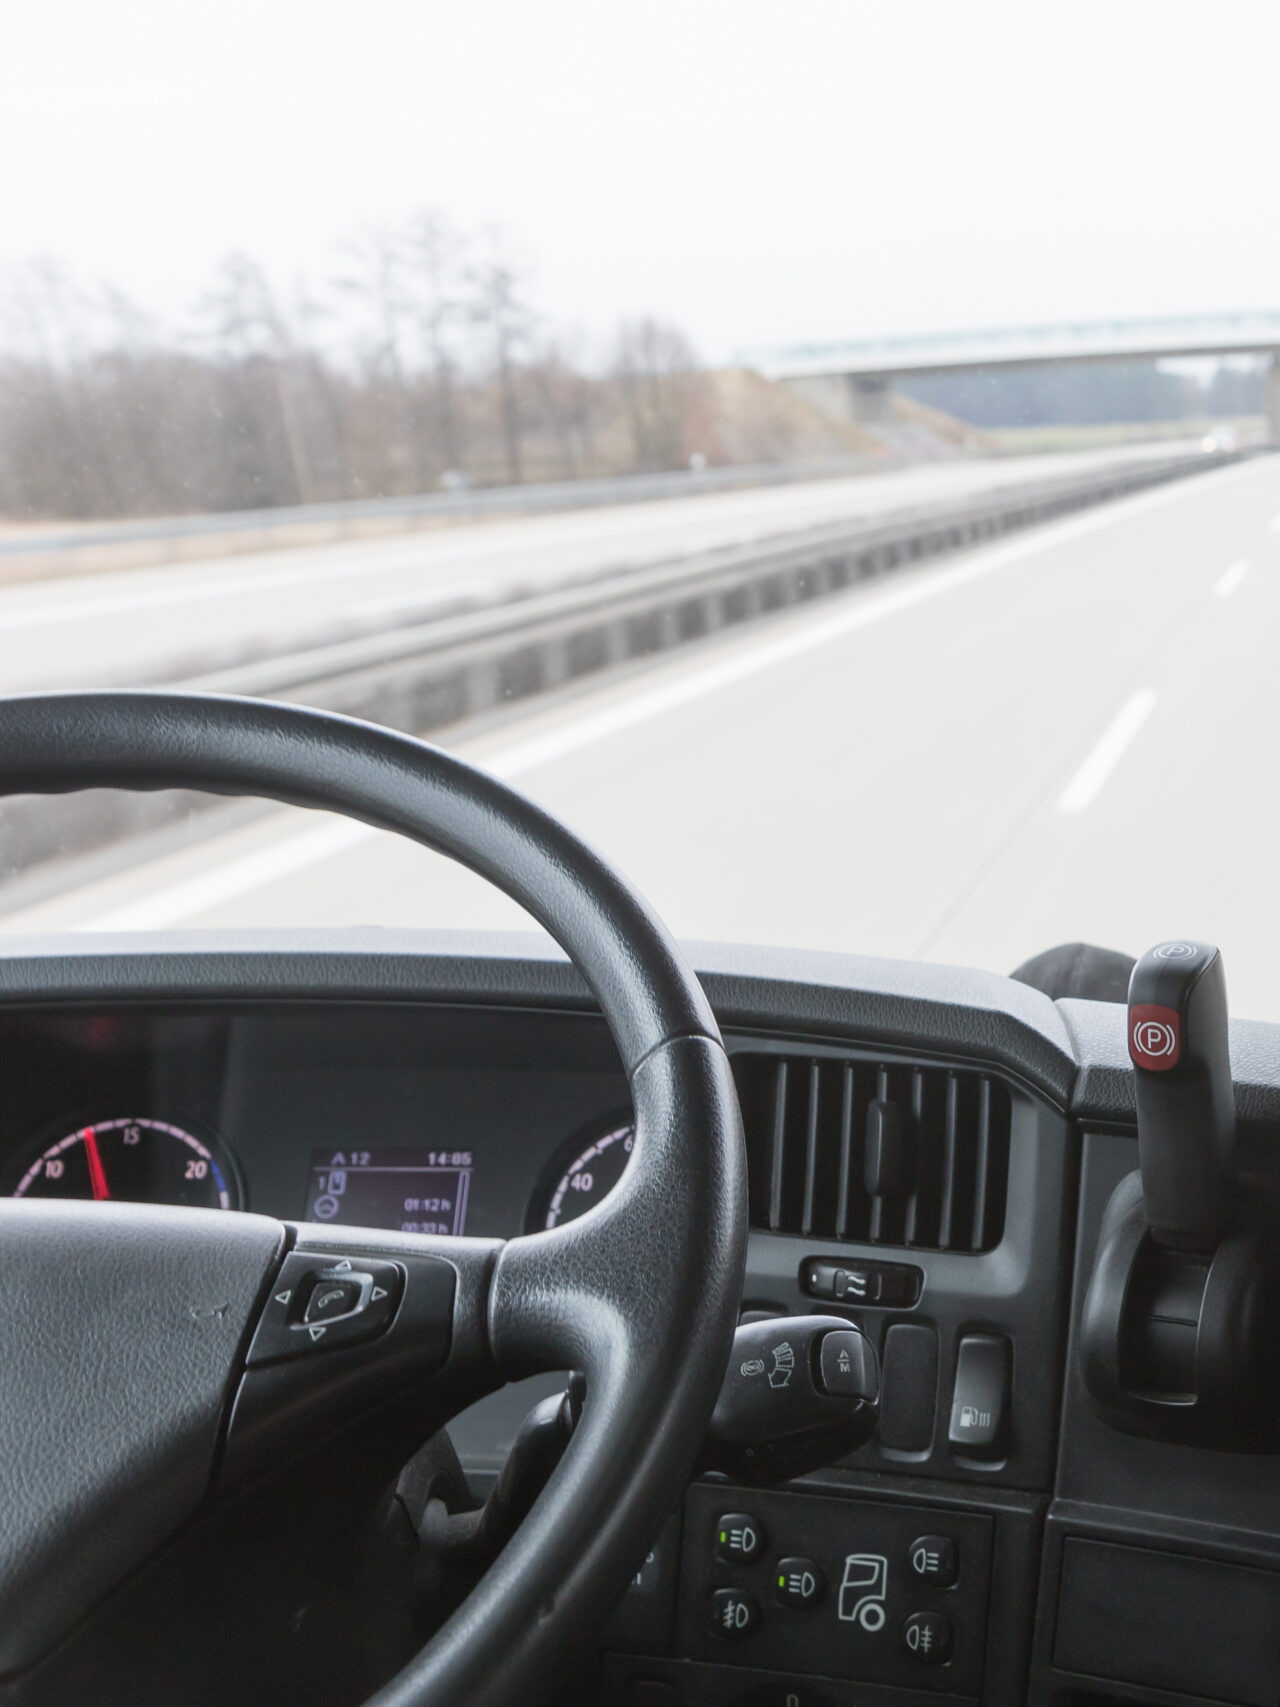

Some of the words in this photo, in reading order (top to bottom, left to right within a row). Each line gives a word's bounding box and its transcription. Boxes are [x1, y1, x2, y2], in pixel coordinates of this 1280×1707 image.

[1147, 1028, 1162, 1049] P
[123, 1127, 141, 1145] 15
[351, 1152, 371, 1165] 12
[45, 1160, 64, 1179] 10
[184, 1160, 208, 1180] 20
[570, 1172, 594, 1192] 40
[840, 1362, 851, 1373] M
